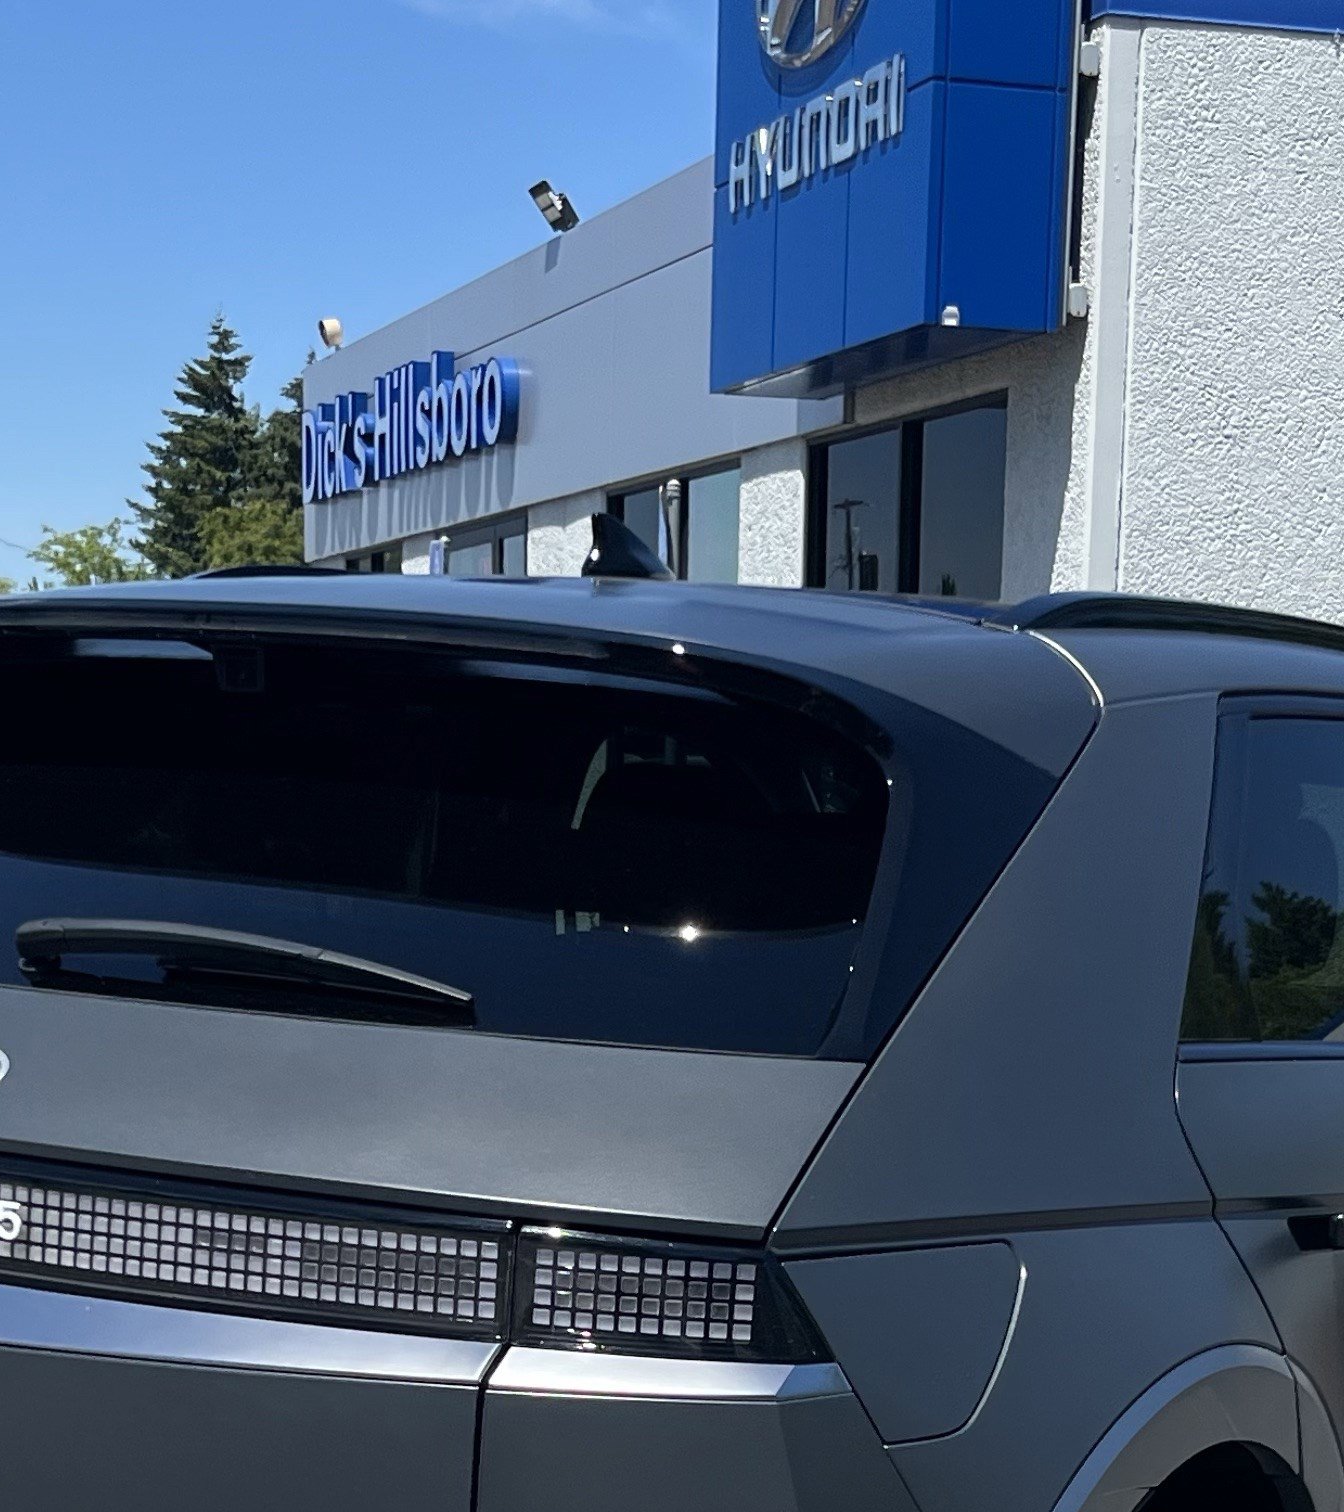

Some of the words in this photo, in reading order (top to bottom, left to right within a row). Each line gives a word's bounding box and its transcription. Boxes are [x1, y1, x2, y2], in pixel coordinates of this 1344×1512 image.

[729, 52, 905, 213] HYUNDAI
[303, 391, 367, 503] Dick's
[374, 351, 512, 482] Hillsboro
